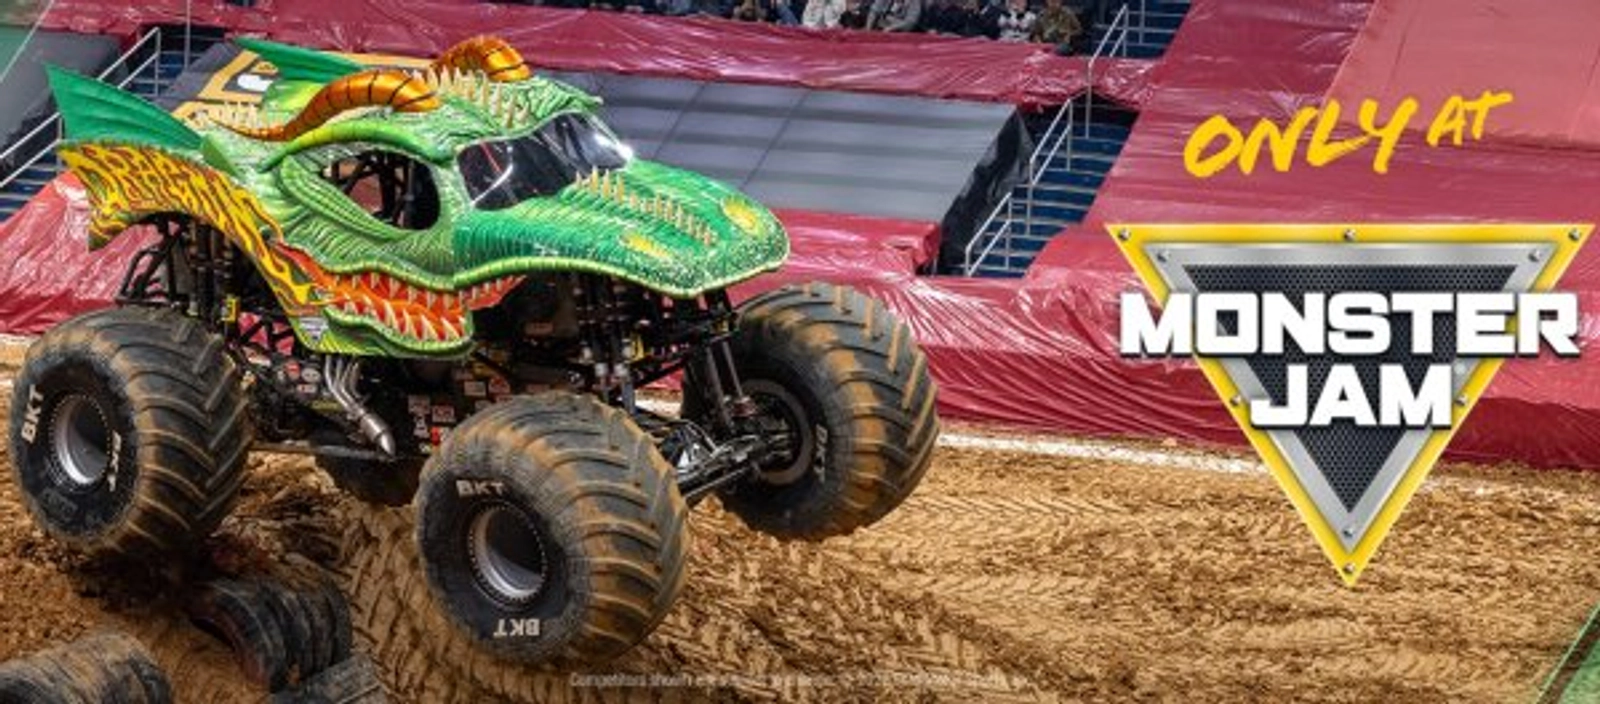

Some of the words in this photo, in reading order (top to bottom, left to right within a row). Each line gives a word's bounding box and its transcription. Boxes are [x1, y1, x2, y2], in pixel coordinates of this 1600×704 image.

[21, 384, 43, 443] BKT
[456, 479, 504, 496] BKT
[493, 619, 539, 637] BKT
